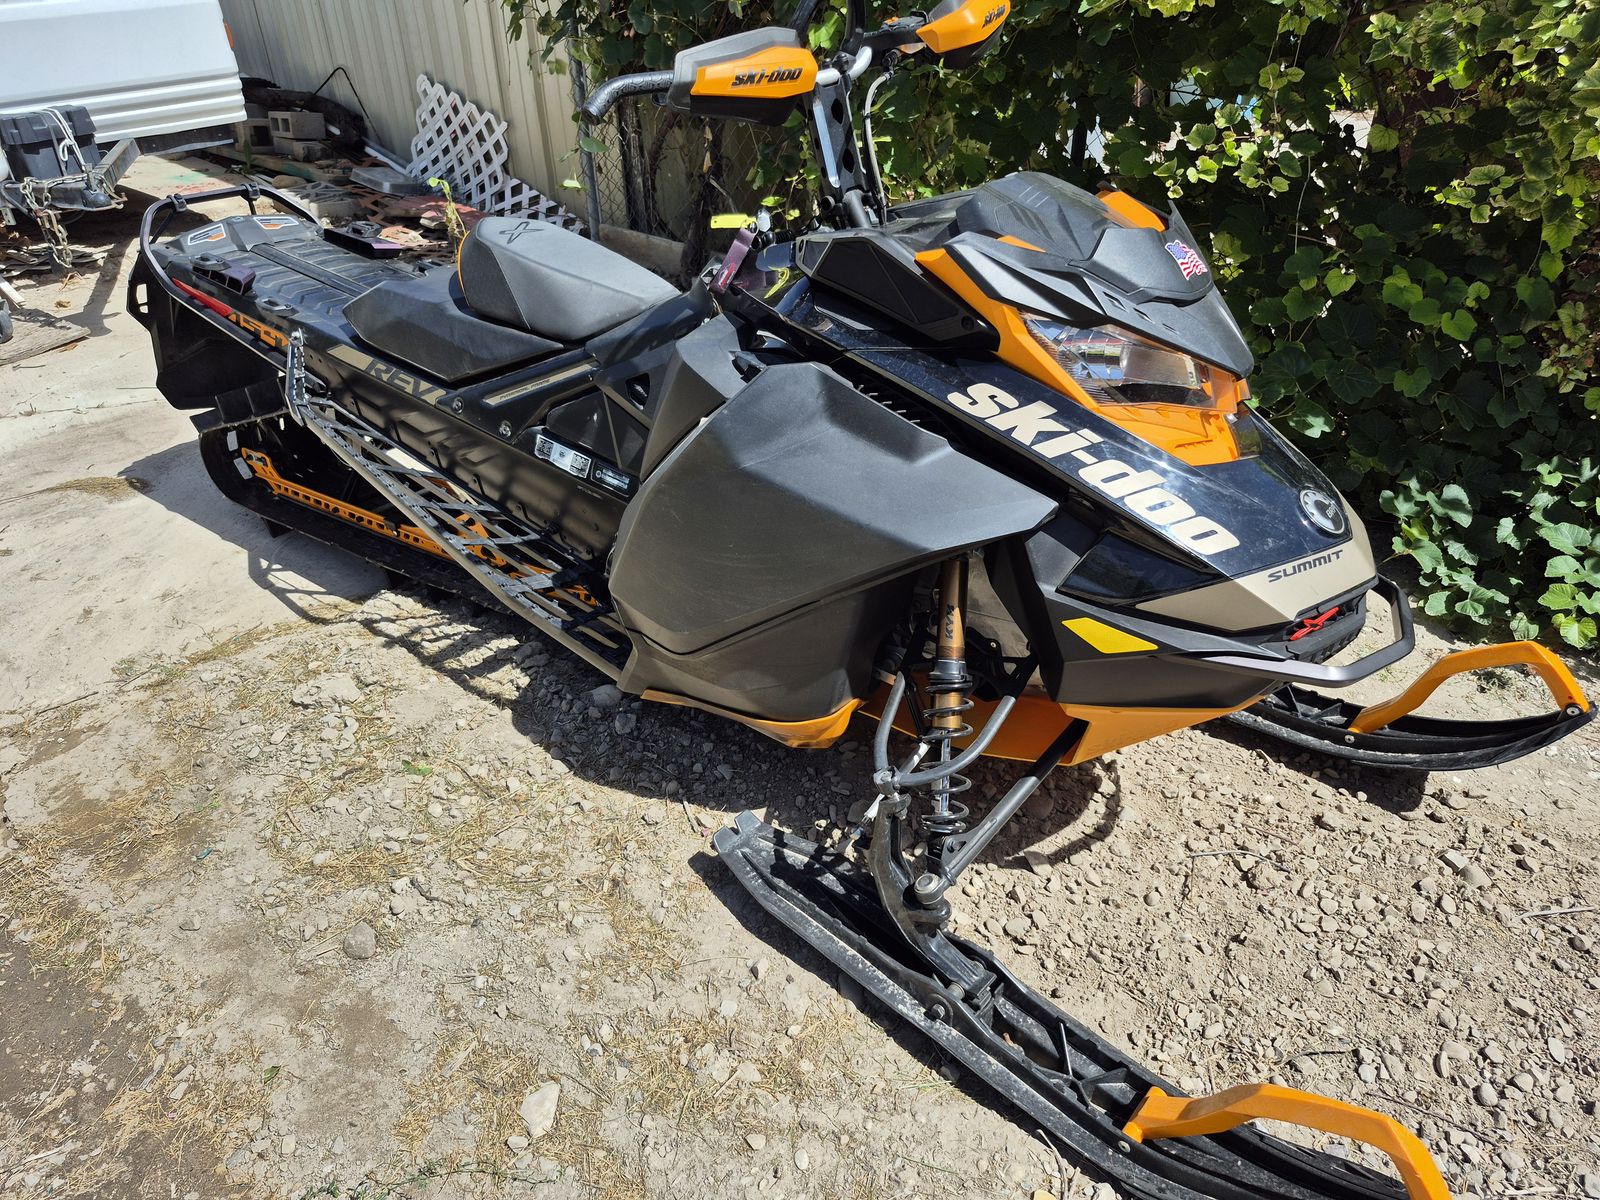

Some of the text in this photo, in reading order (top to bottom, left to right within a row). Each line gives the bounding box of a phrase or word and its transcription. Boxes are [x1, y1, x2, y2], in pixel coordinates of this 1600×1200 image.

[731, 66, 803, 86] ski-doo
[364, 358, 441, 399] REV
[947, 382, 1240, 556] ski-doo
[1267, 549, 1344, 583] SUMMIT
